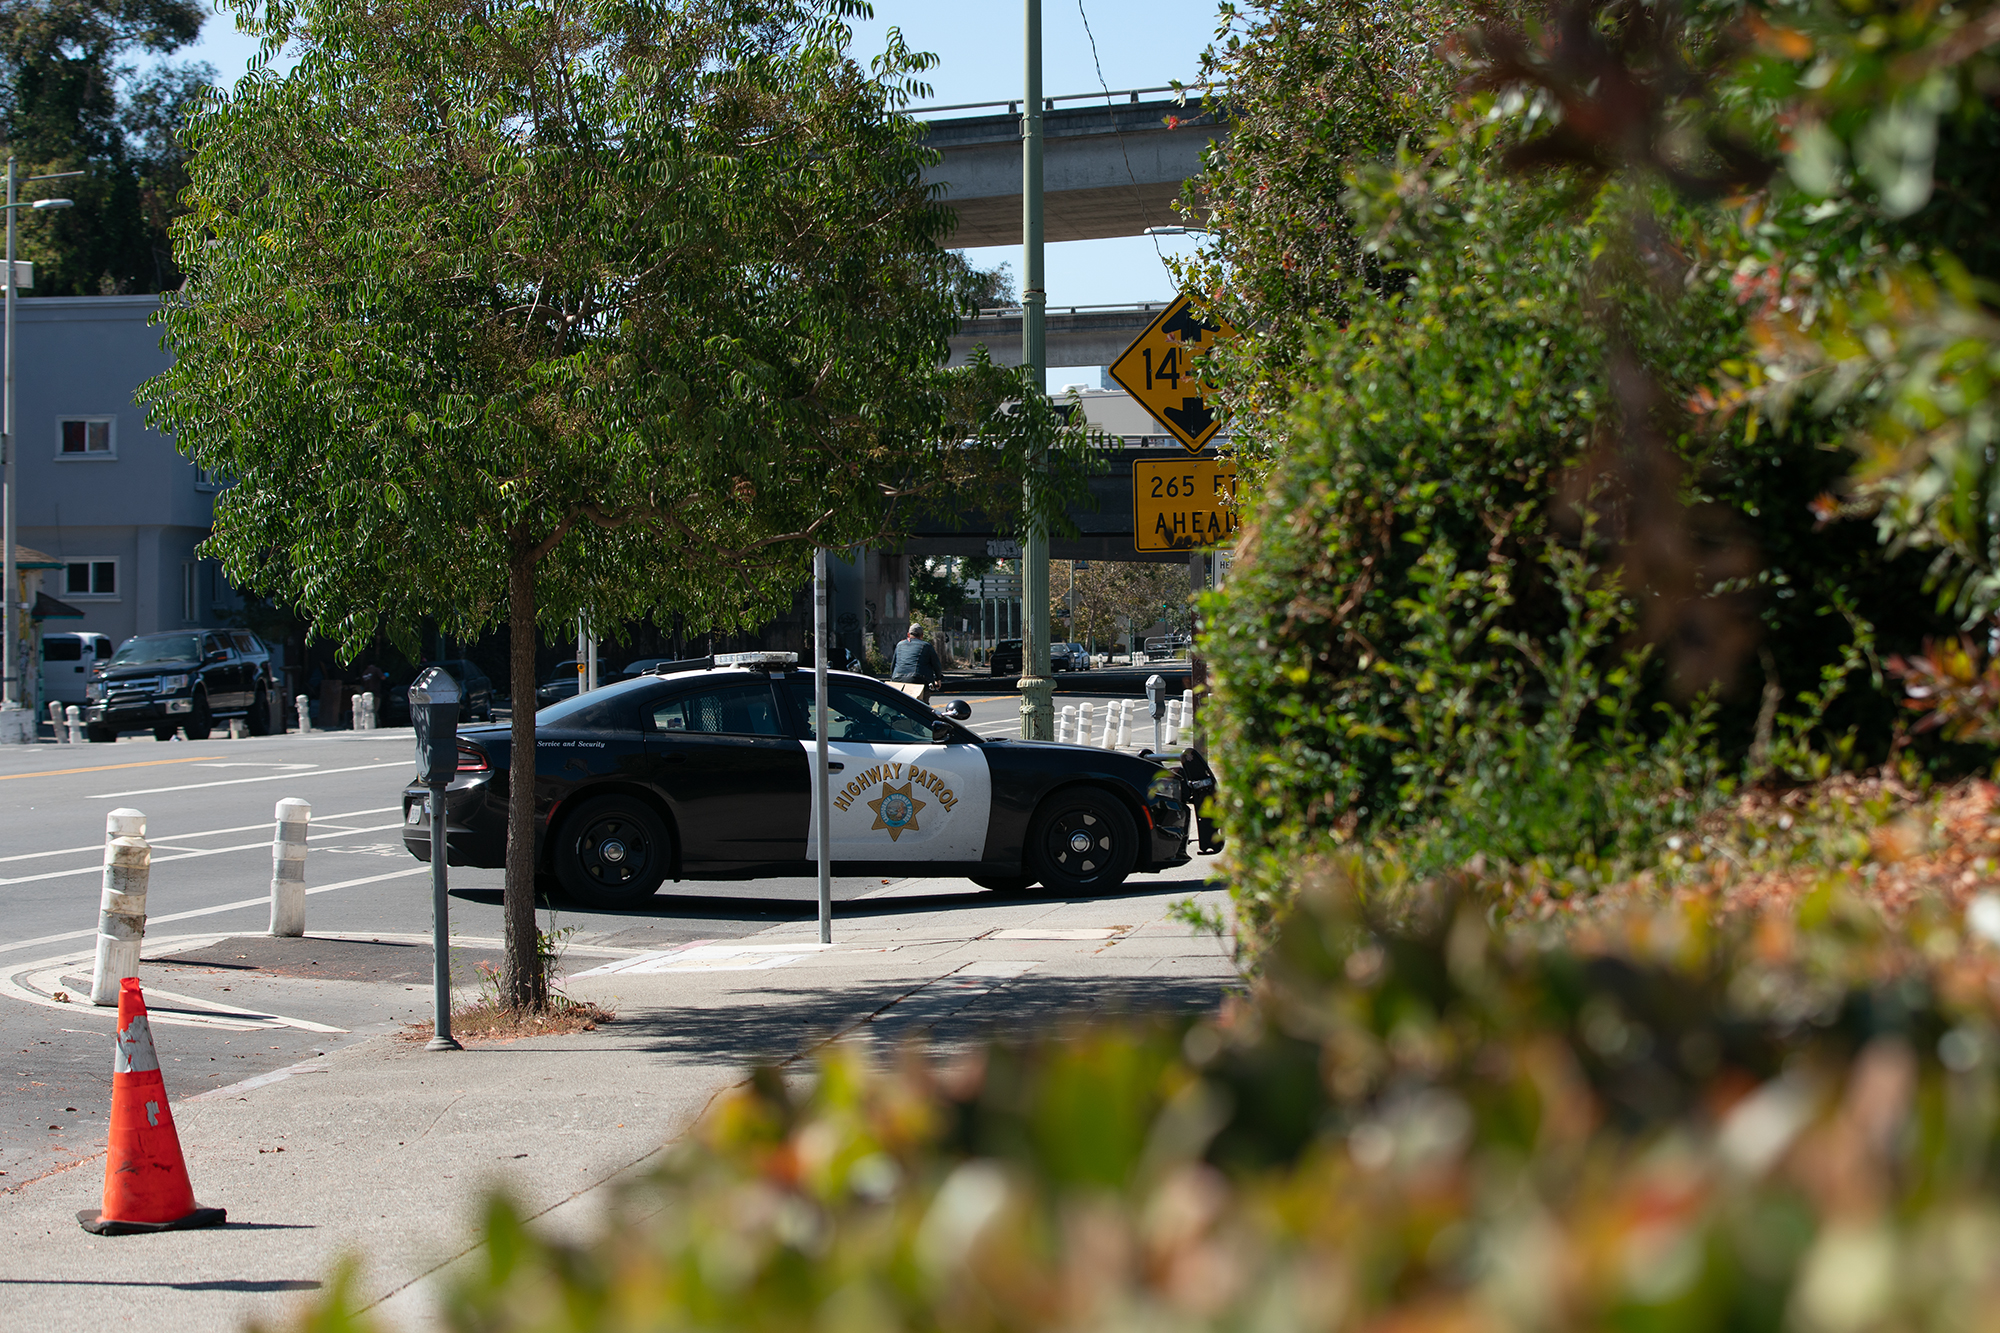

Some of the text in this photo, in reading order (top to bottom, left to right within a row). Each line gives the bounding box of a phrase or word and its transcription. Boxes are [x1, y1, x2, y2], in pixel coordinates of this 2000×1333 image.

[1150, 475, 1195, 498] 265
[1154, 511, 1239, 534] AHEAD
[833, 763, 958, 812] HIGHWAY PATROL
